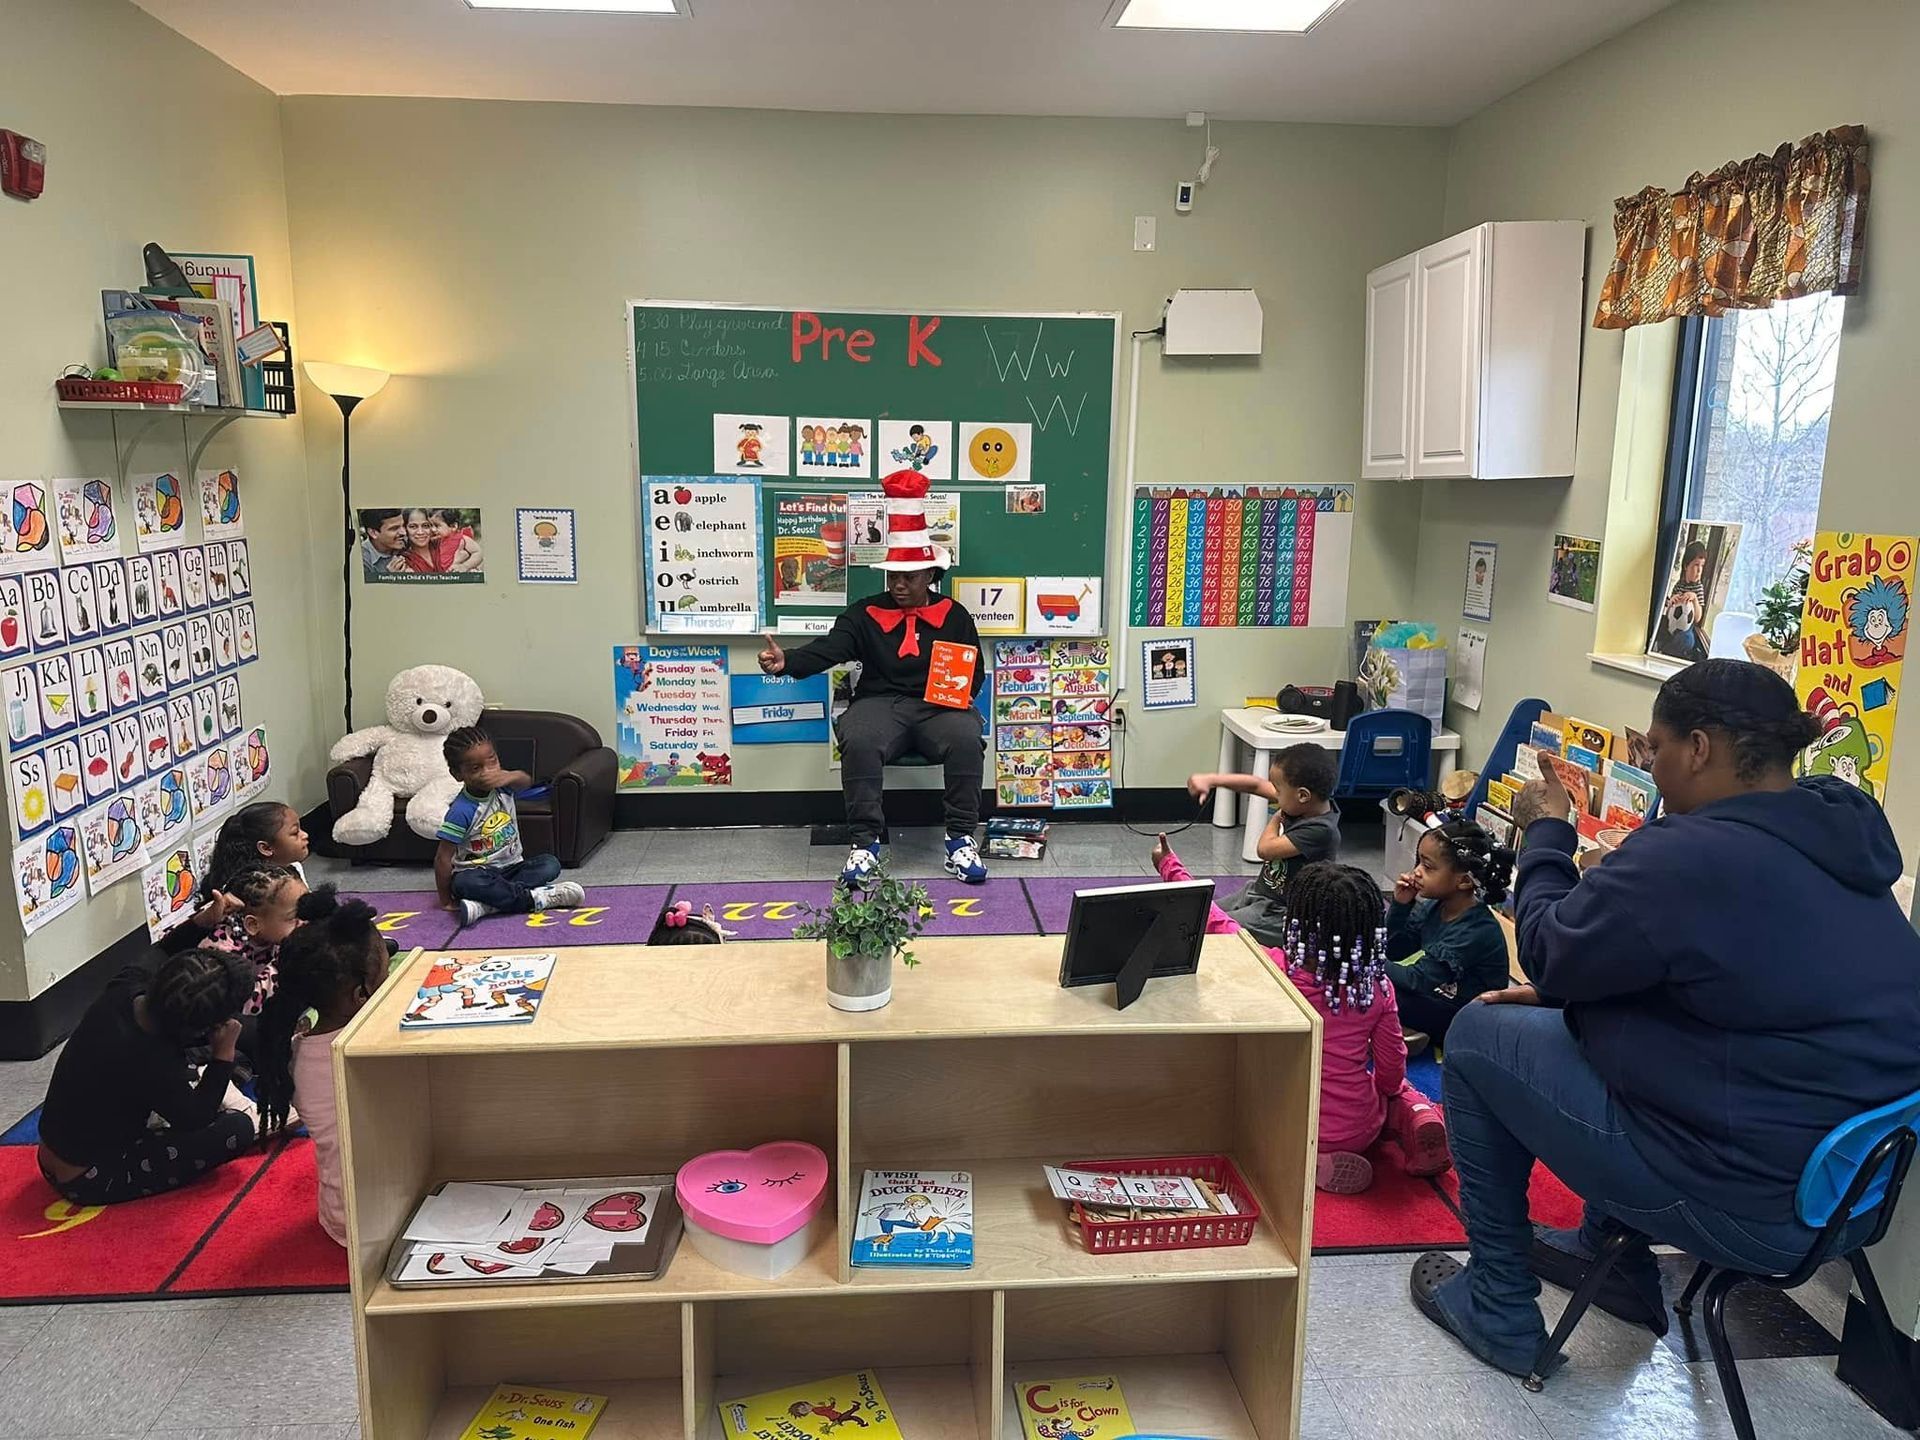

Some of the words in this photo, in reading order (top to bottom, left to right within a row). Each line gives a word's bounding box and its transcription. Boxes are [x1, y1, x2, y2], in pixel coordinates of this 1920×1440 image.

[791, 312, 875, 363] Pre
[908, 316, 942, 367] K
[654, 488, 671, 505] a
[695, 494, 727, 505] apple
[780, 502, 804, 512] Let's
[806, 502, 827, 512] Find
[829, 502, 847, 513] Out
[1139, 500, 1147, 511] 0
[1155, 500, 1168, 511] 10
[1172, 500, 1187, 511] 20
[1189, 500, 1205, 511] 30
[1208, 500, 1223, 511] 40
[1226, 500, 1242, 511] 50
[1245, 500, 1260, 511] 60
[1264, 500, 1278, 511] 70
[1281, 500, 1297, 511] 80
[1300, 500, 1314, 511] 90
[1316, 500, 1333, 511] 100
[655, 515, 671, 531] e
[696, 521, 747, 532] elephant
[777, 518, 798, 527] Happy
[792, 524, 816, 534] Seuss!
[208, 546, 224, 567] Hh
[230, 543, 239, 563] Ii
[660, 541, 670, 562] i
[697, 549, 754, 558] inchworm
[1815, 537, 1882, 582] Grab
[132, 560, 149, 582] Ee
[159, 554, 173, 578] Ff
[184, 551, 201, 576] Gg
[68, 570, 89, 594] Cc
[98, 562, 120, 588] Dd
[657, 573, 674, 588] o
[698, 577, 739, 586] ostrich
[0, 587, 18, 607] Aa
[30, 575, 55, 602] Bb
[981, 588, 1002, 606] 17
[658, 600, 675, 612] u
[700, 603, 752, 612] umbrella
[1807, 597, 1840, 623] Your
[238, 608, 251, 628] Rr
[684, 617, 735, 628] Thursday
[969, 610, 1014, 621] eventeen
[192, 621, 207, 645] Pp
[215, 614, 231, 637] Qq
[167, 629, 184, 649] Oo
[140, 638, 158, 660] Nn
[649, 647, 679, 658] Days
[687, 646, 720, 657] Week
[1801, 629, 1846, 667] Hat
[81, 650, 97, 676] Ll
[107, 646, 133, 669] Mm
[1006, 654, 1045, 666] January
[1071, 654, 1090, 666] July
[41, 658, 67, 688] Kk
[656, 664, 696, 674] Sunday
[15, 668, 28, 702] Jj
[656, 677, 696, 687] Monday
[761, 676, 785, 686] Today
[1003, 682, 1047, 693] February
[1063, 682, 1100, 694] August
[1823, 673, 1852, 696] and
[221, 680, 236, 701] Zz
[653, 690, 697, 700] Tuesday
[197, 690, 213, 714] Yy
[636, 703, 697, 713] Wednesday
[172, 699, 191, 723] Xx
[762, 706, 795, 719] Friday
[1009, 709, 1042, 720] March
[143, 712, 166, 734] Ww
[650, 716, 697, 725] Thursday
[116, 721, 136, 744] Vv
[665, 728, 698, 738] Friday
[85, 734, 107, 758] Uu
[650, 741, 698, 751] Saturday
[1013, 738, 1039, 749] April
[1063, 740, 1100, 749] October
[53, 745, 73, 771] Tt
[20, 761, 40, 786] Ss
[1014, 765, 1038, 777] May
[1059, 768, 1104, 777] November
[1016, 791, 1039, 803] June
[1061, 795, 1103, 805] December
[473, 969, 535, 986] KNEE
[489, 979, 527, 990] BOOK
[1067, 1176, 1081, 1187] Q
[1135, 1182, 1148, 1194] R
[870, 1185, 917, 1197] DUCK
[920, 1185, 969, 1198] FEET
[507, 1392, 527, 1404] Dr.
[530, 1394, 566, 1409] Seuss
[1026, 1384, 1059, 1414] C
[1059, 1398, 1069, 1408] is
[1069, 1399, 1085, 1409] for
[534, 1416, 552, 1426] One
[555, 1418, 576, 1429] fish
[1077, 1406, 1119, 1422] Clown
